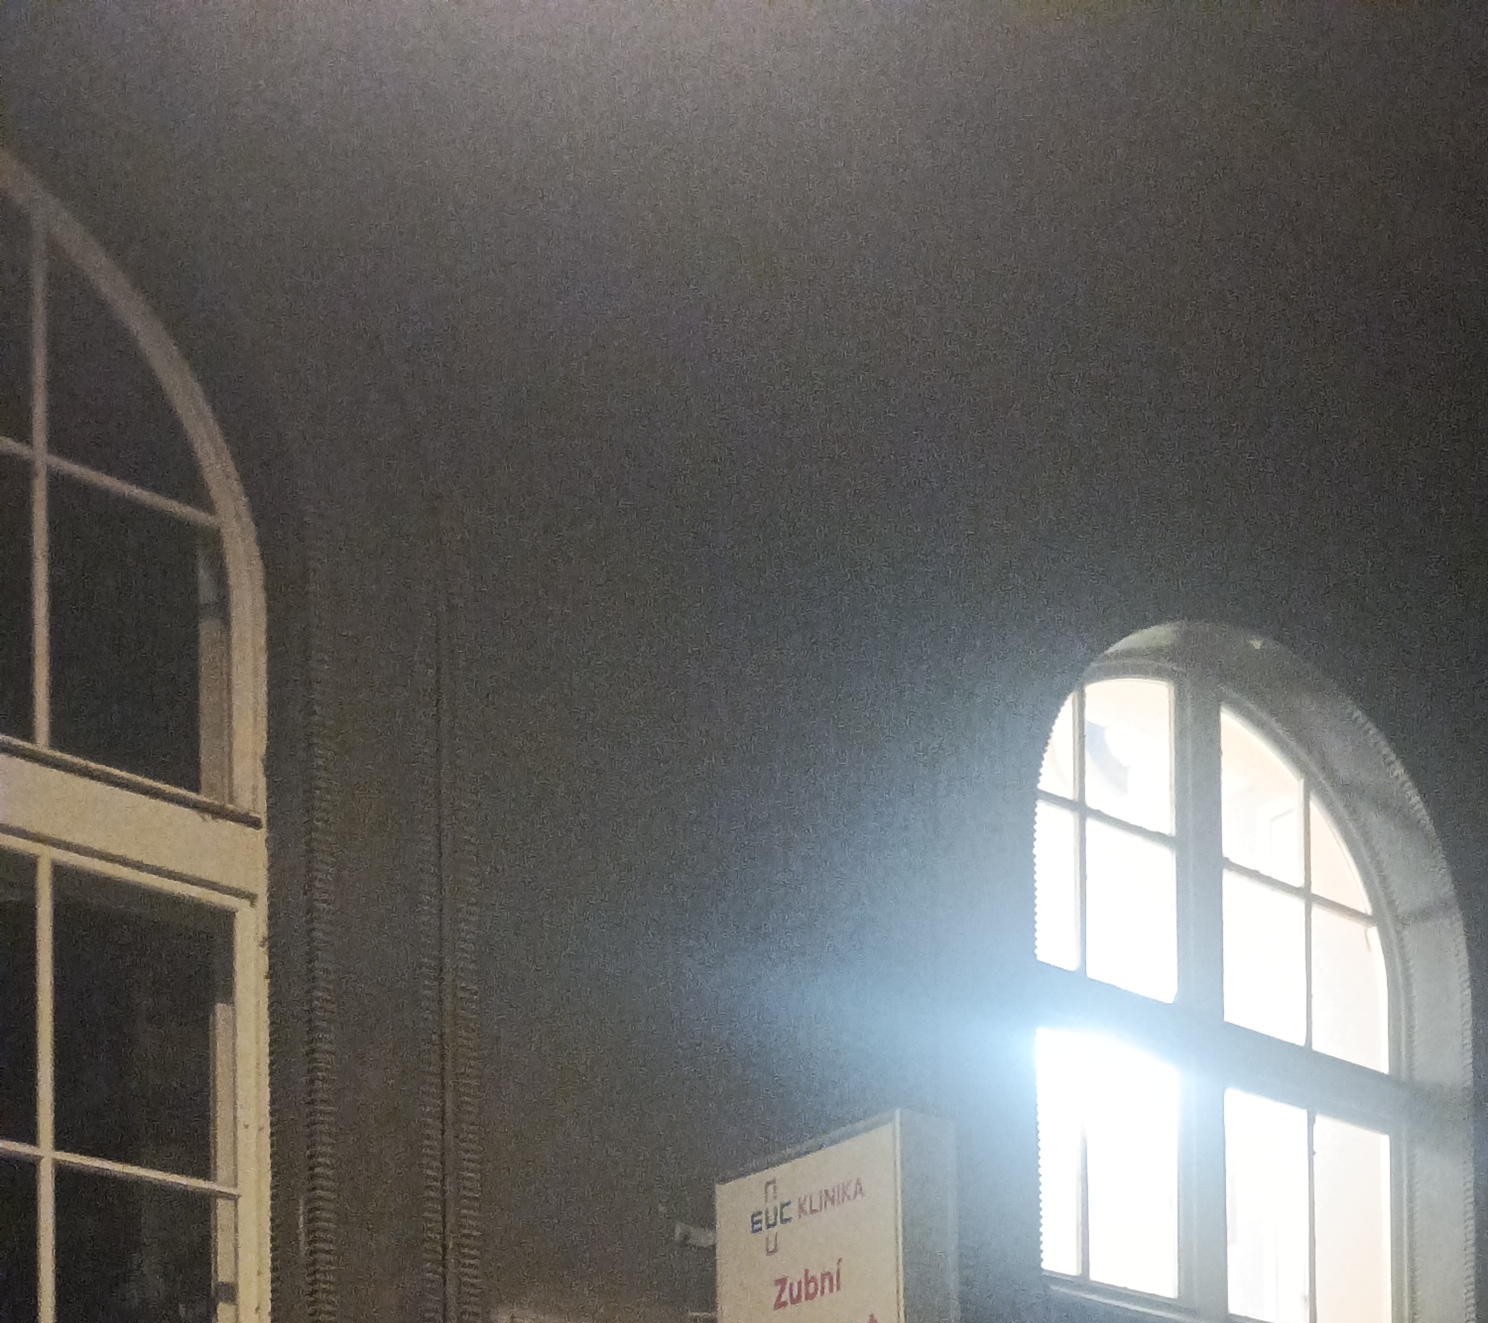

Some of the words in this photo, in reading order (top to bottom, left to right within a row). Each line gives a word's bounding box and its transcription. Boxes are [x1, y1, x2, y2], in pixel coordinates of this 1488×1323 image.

[750, 1200, 792, 1234] EUC
[797, 1177, 866, 1219] KLINIKA
[772, 1257, 843, 1312] Zubní
